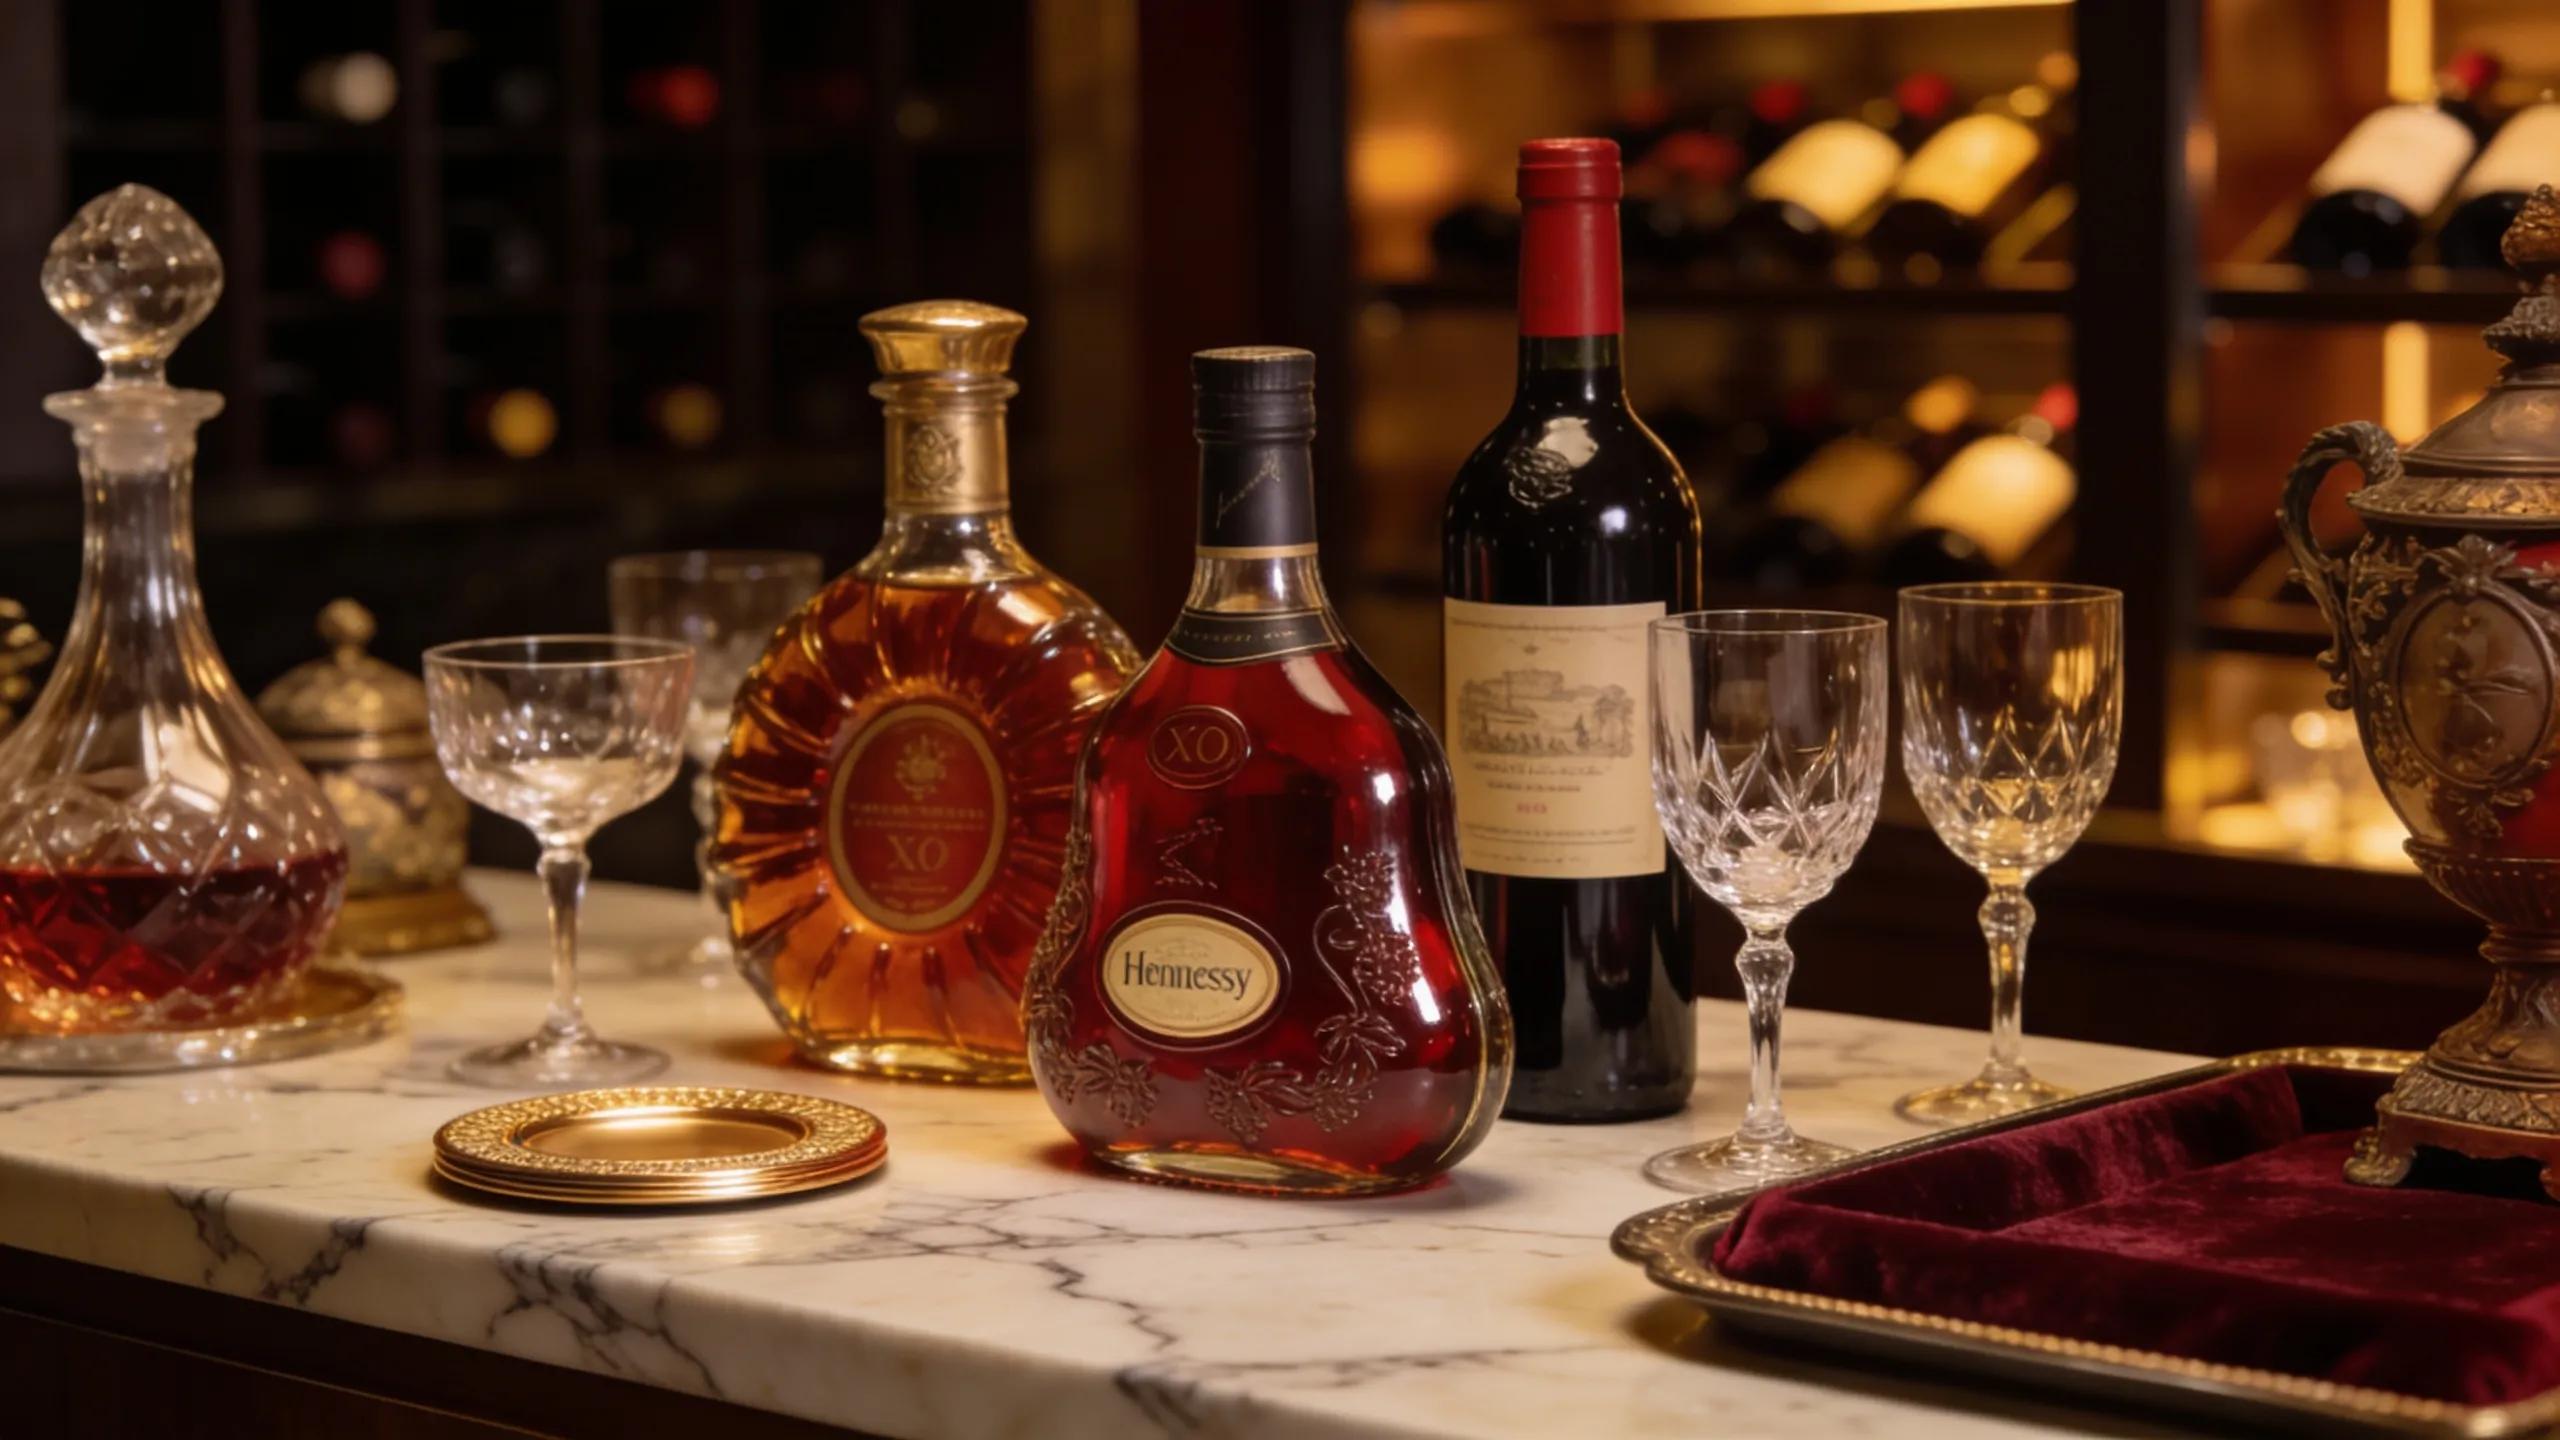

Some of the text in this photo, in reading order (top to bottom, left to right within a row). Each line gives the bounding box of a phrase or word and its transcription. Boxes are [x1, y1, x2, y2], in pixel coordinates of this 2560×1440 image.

[1165, 725, 1229, 764] XO
[887, 834, 950, 873] XO
[1123, 950, 1253, 1001] Hennessy
